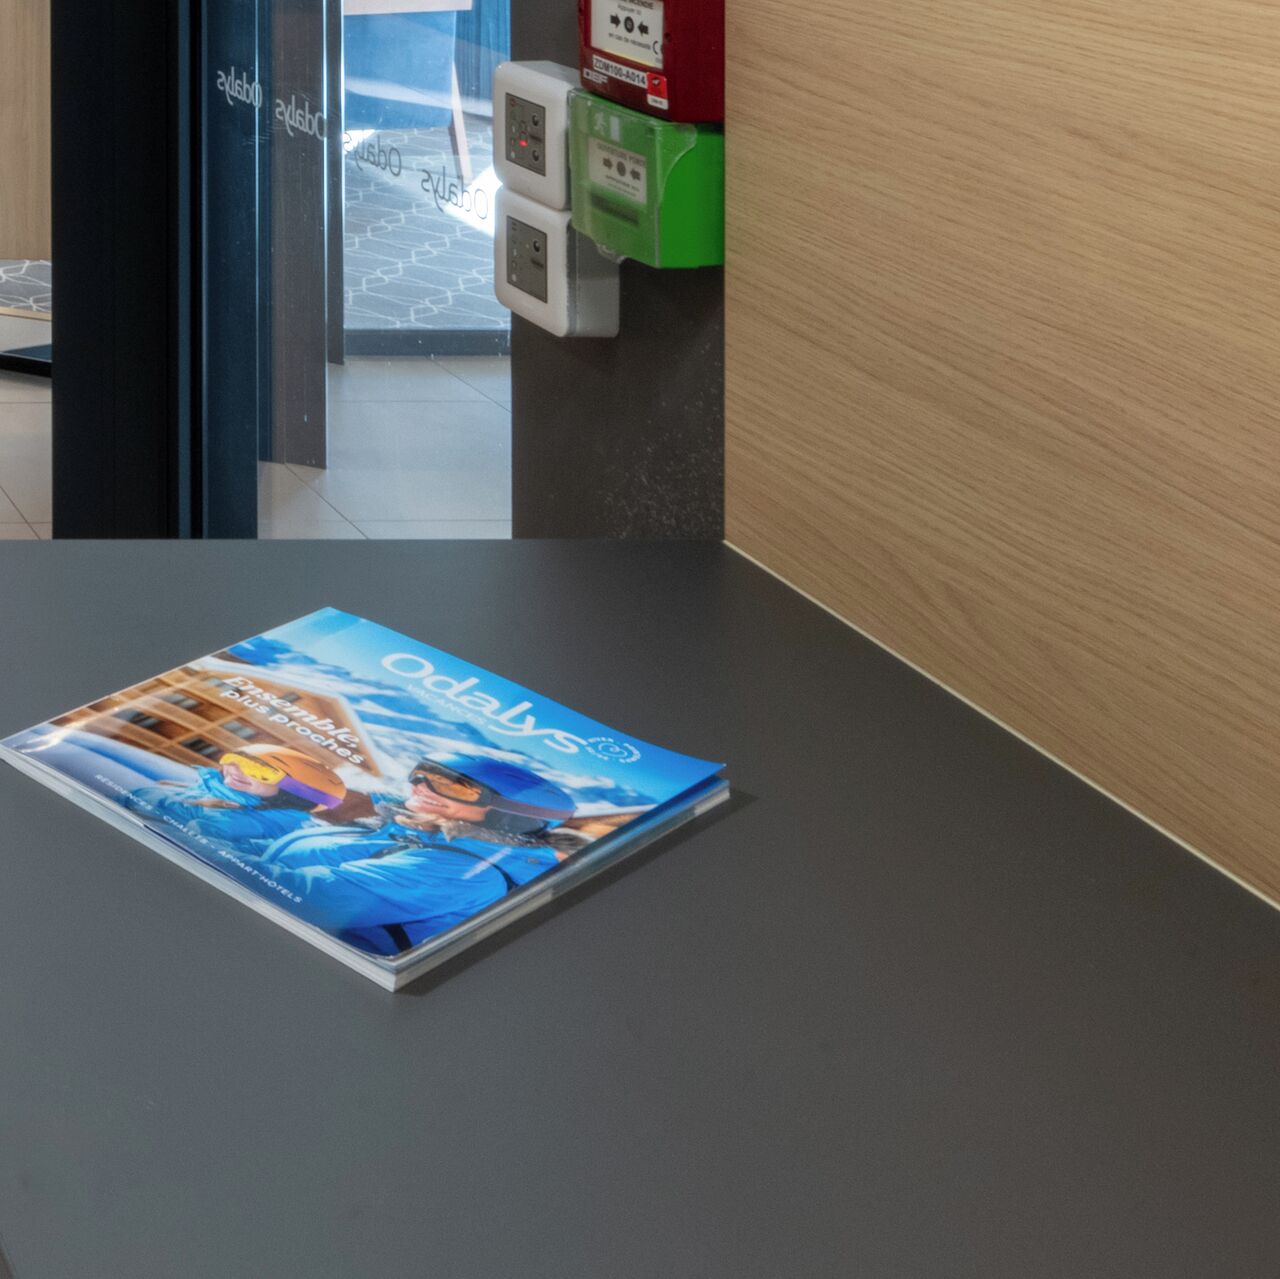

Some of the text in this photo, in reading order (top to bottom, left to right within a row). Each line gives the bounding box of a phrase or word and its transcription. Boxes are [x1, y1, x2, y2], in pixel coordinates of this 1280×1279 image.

[220, 689, 365, 765] plus proches
[222, 676, 361, 749] Ensemble,
[381, 652, 587, 755] Odalys
